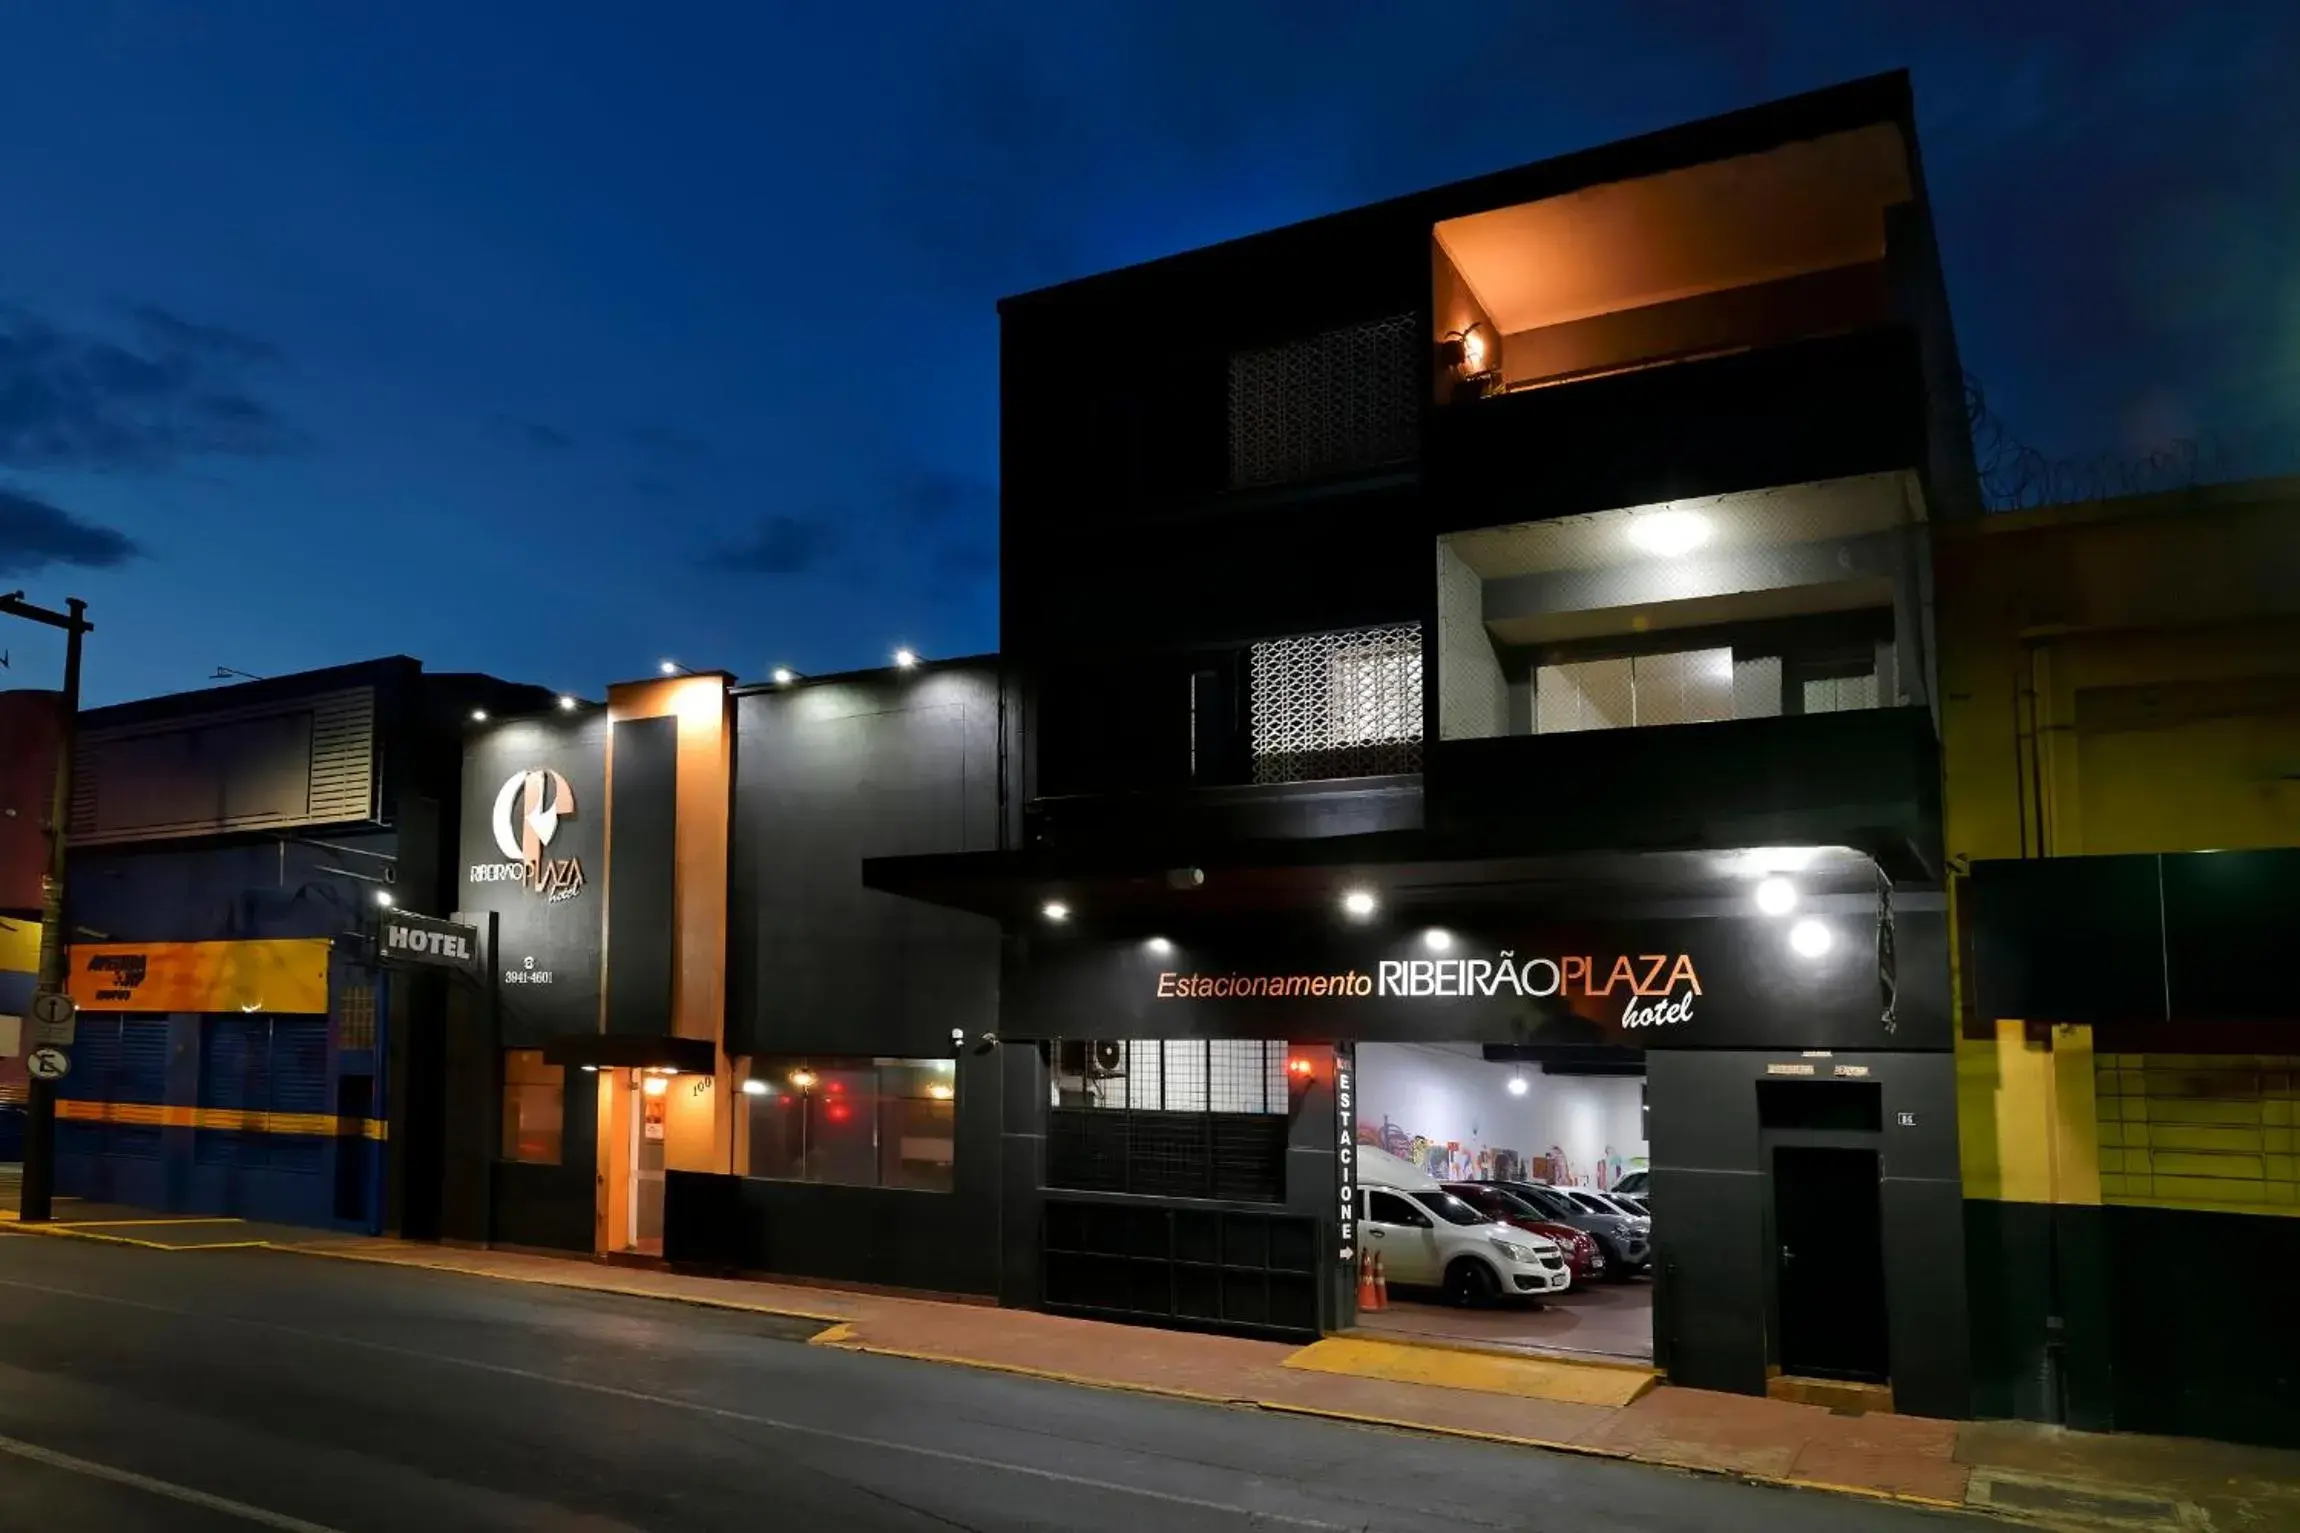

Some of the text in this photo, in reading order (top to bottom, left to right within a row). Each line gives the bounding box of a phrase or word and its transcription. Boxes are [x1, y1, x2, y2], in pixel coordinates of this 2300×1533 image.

[388, 925, 470, 959] HOTEL
[505, 971, 553, 984] 3941-4601
[1157, 970, 1372, 998] Estacionamento
[1621, 991, 1693, 1029] hotel
[692, 1075, 711, 1097] 100
[1339, 1074, 1353, 1239] ESTACIONE
